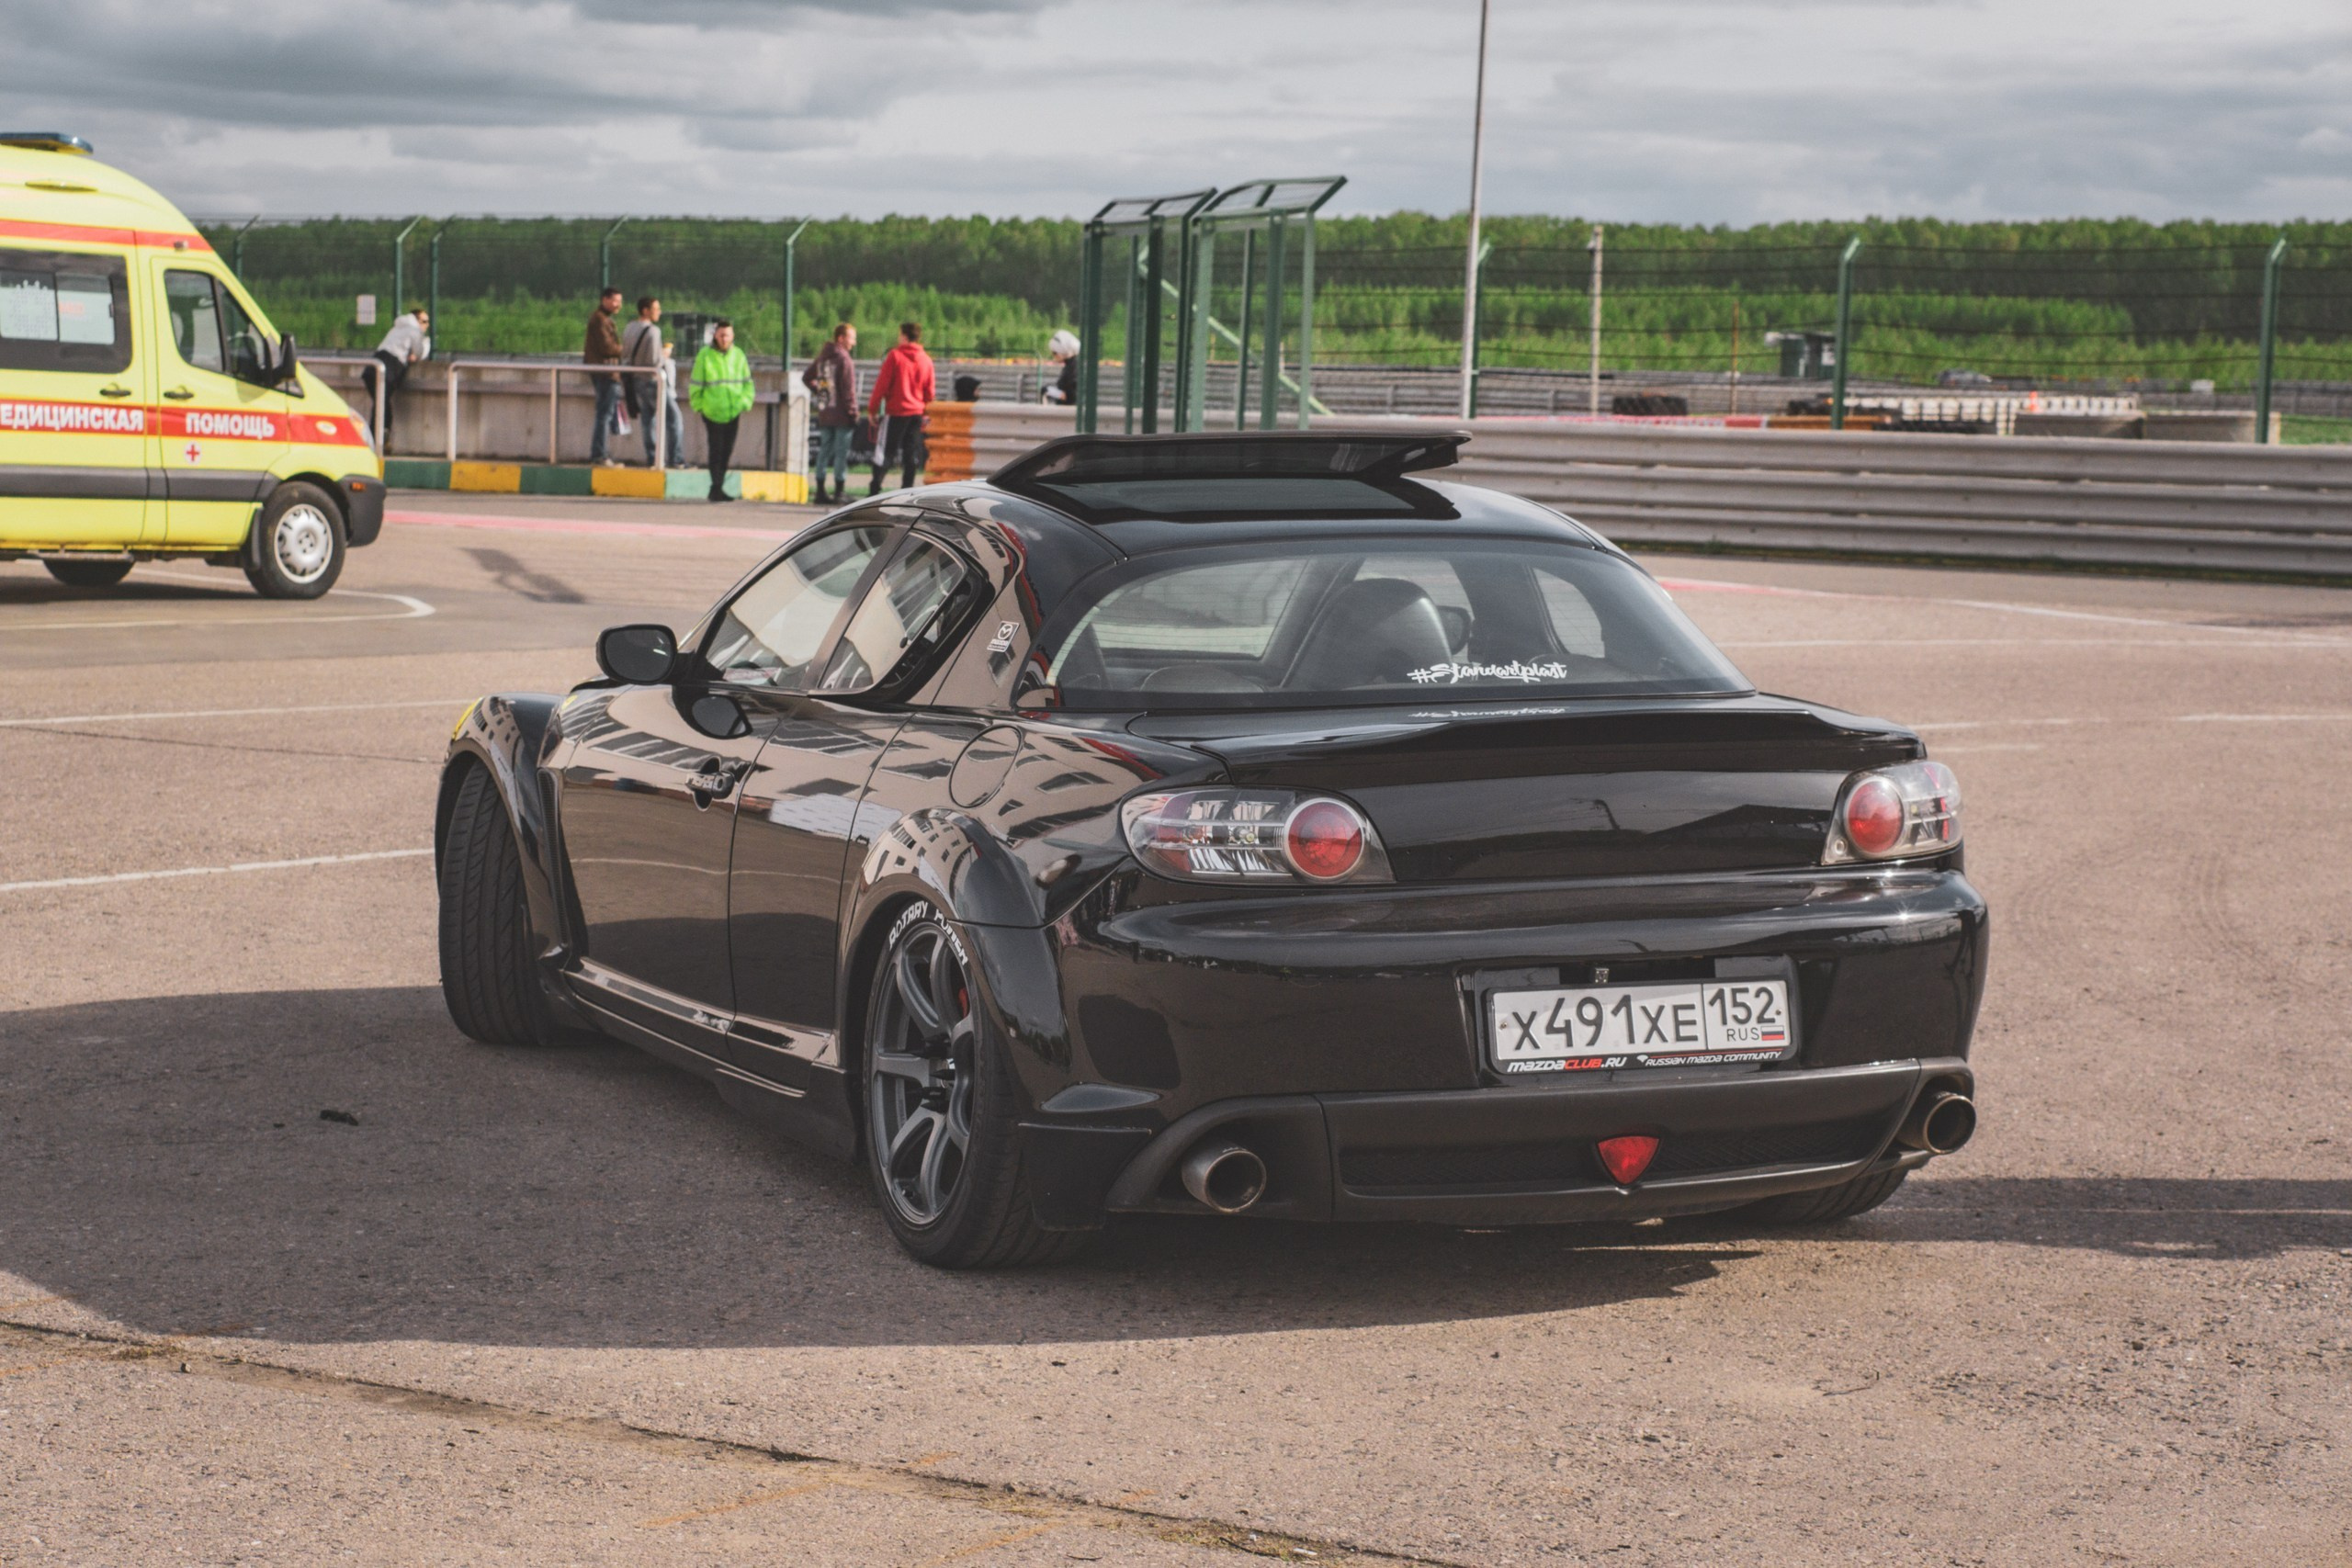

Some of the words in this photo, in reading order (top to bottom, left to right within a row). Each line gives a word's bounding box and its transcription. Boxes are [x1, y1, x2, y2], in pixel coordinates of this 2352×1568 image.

[0, 404, 144, 430] ЕДИЦИНСКАЯ
[186, 412, 275, 439] ПОМОЩЬ
[889, 900, 928, 951] ROTARY
[1512, 994, 1698, 1051] X491XE
[1709, 987, 1776, 1025] 152
[1726, 1027, 1759, 1042] RUS
[1645, 1055, 1686, 1066] RUSSIAN
